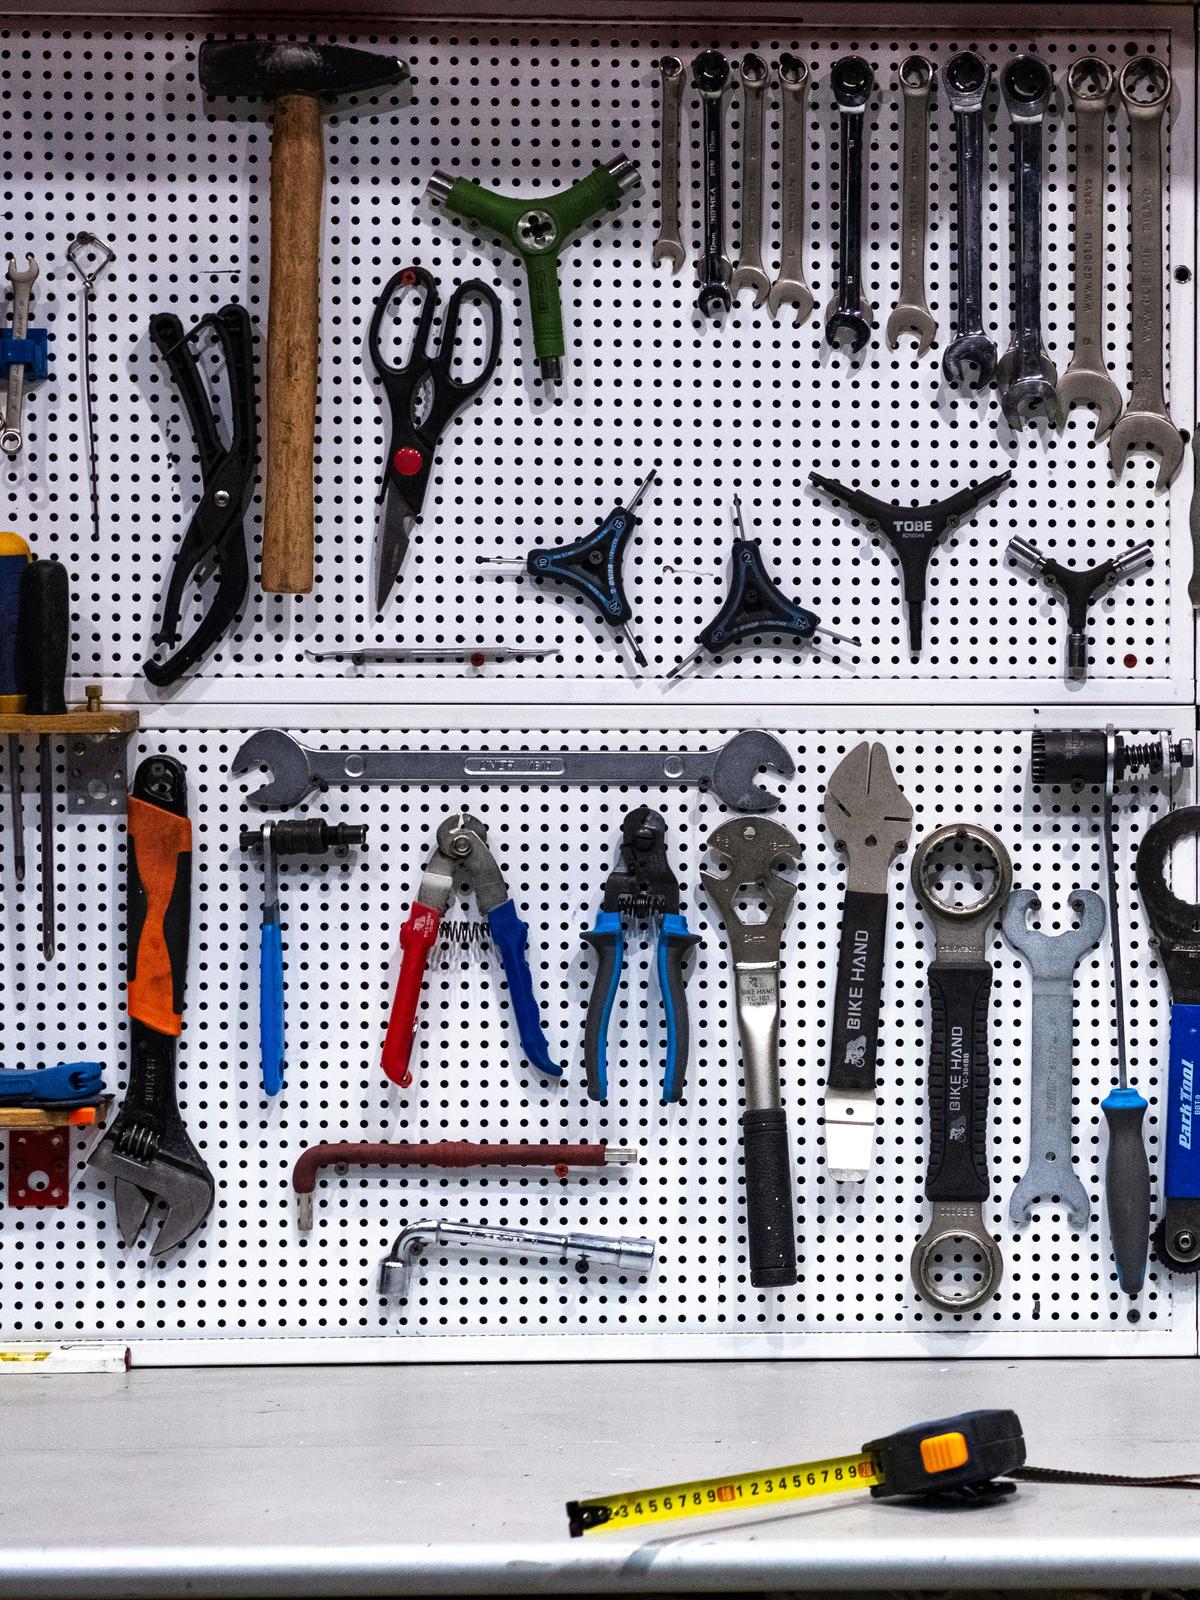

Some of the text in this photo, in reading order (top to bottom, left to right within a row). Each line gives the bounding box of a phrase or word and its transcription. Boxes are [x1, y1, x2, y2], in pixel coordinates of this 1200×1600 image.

[613, 519, 624, 529] 15
[892, 520, 933, 532] TOBE
[538, 558, 548, 567] 10
[743, 553, 752, 564] 2
[847, 930, 869, 1030] BIKE HAND
[950, 1026, 963, 1111] BIKE HAND
[1179, 1058, 1194, 1150] Park Tool
[620, 1505, 629, 1518] 3
[634, 1502, 643, 1515] 4
[649, 1500, 658, 1512] 5
[664, 1498, 673, 1510] 6
[679, 1495, 687, 1507] 7
[693, 1492, 702, 1505] 8
[708, 1490, 717, 1502] 9
[721, 1488, 732, 1500] 10
[736, 1486, 743, 1497] 1
[751, 1483, 759, 1495] 2
[765, 1480, 773, 1493] 3
[778, 1477, 787, 1490] 4
[793, 1475, 801, 1488] 5
[807, 1473, 816, 1485] 6
[821, 1470, 829, 1483] 7
[835, 1467, 843, 1480] 8
[848, 1465, 857, 1478] 9
